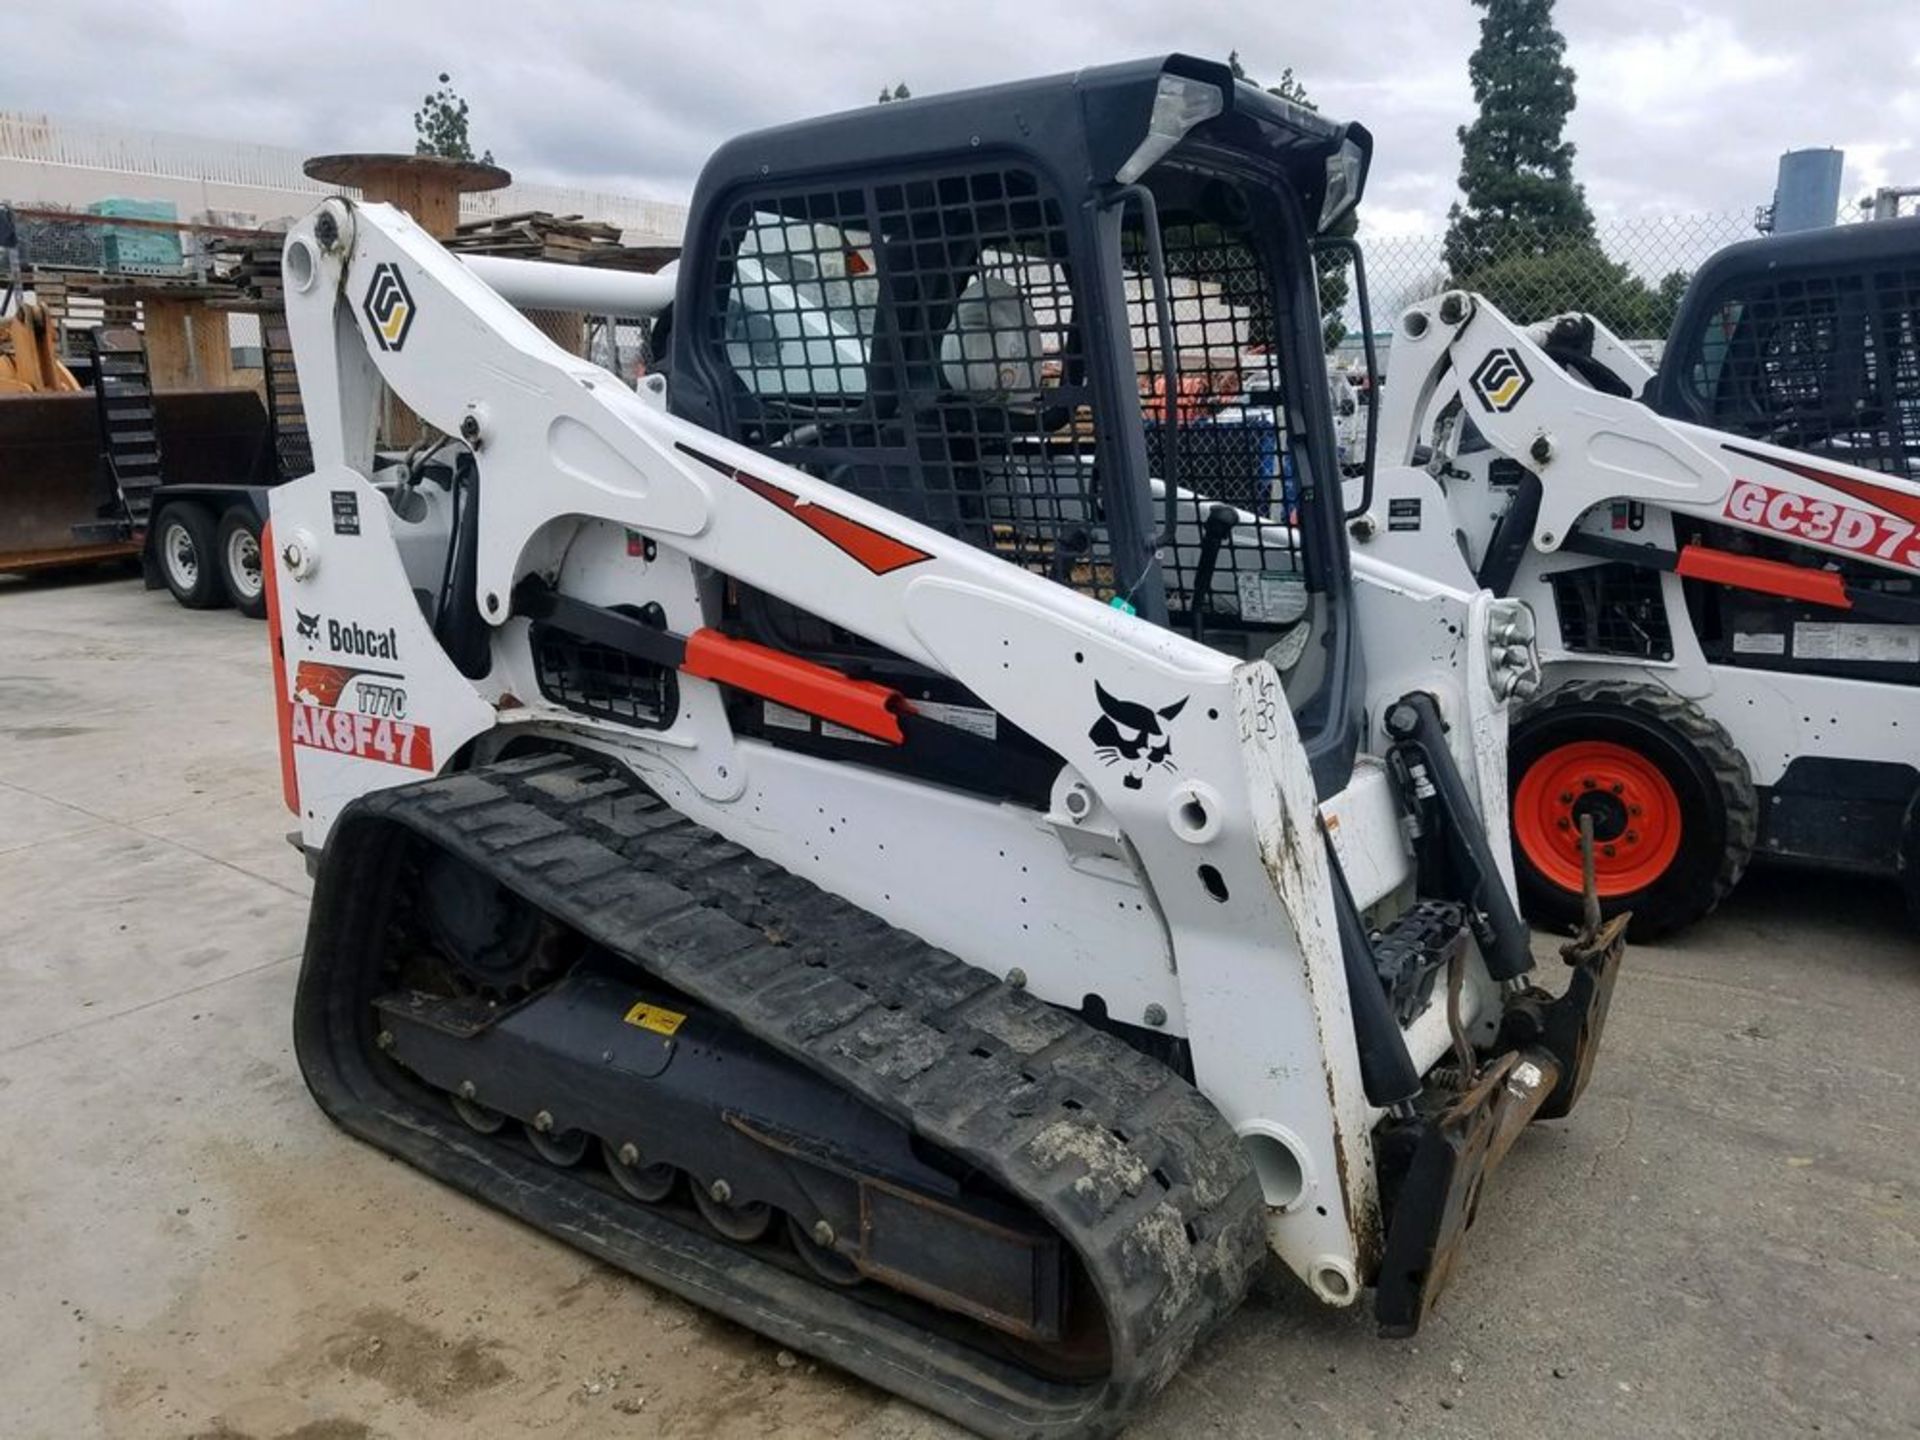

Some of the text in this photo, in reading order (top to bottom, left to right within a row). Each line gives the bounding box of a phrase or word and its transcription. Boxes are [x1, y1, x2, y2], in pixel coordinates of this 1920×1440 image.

[328, 620, 398, 660] Bobcat
[356, 683, 407, 719] T770
[292, 704, 415, 765] AK8F47
